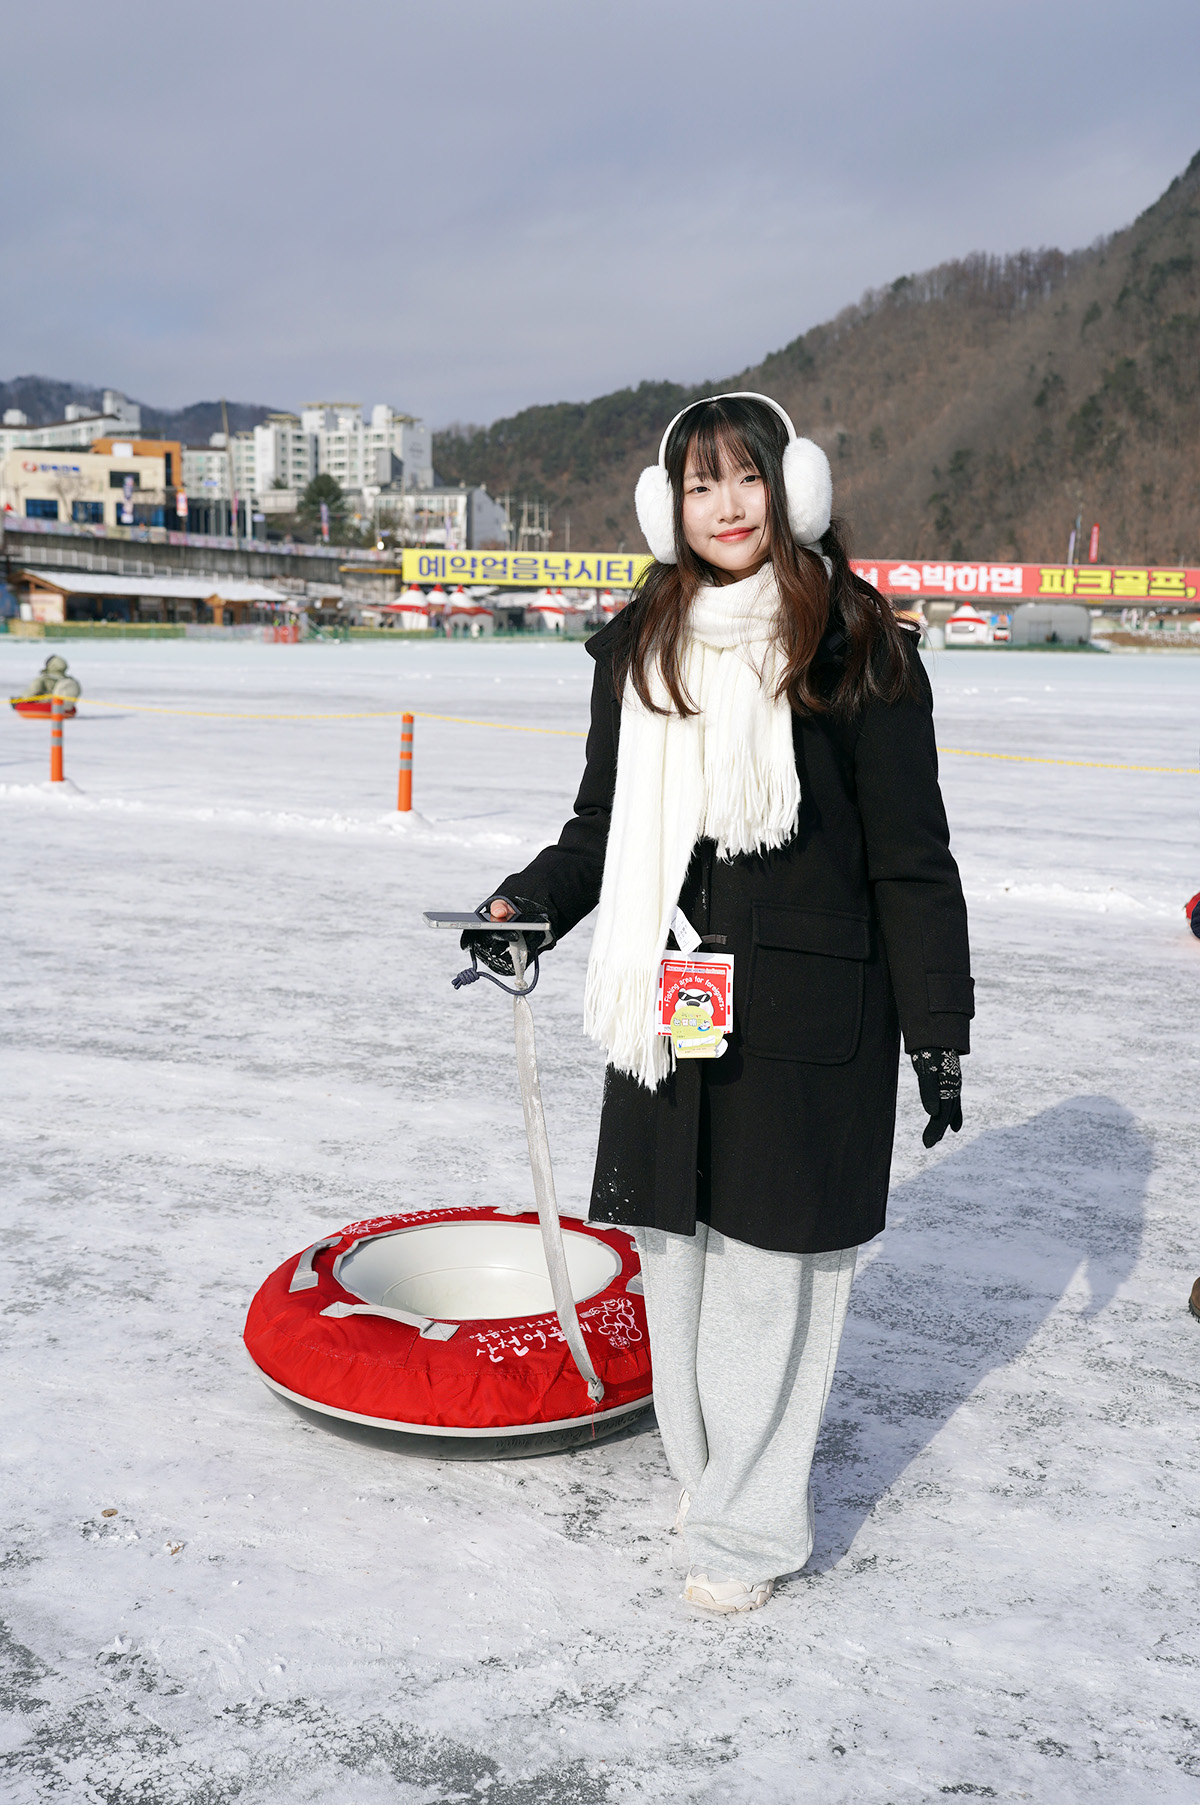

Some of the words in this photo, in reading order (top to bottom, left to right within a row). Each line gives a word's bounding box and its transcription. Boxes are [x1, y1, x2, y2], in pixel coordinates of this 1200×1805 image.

[418, 555, 634, 582] 예약얼음낚시터
[887, 564, 1023, 593] 숙박하면
[664, 984, 680, 1003] Fishing
[679, 976, 693, 986] area
[694, 975, 705, 984] for
[705, 979, 725, 1008] foreigners
